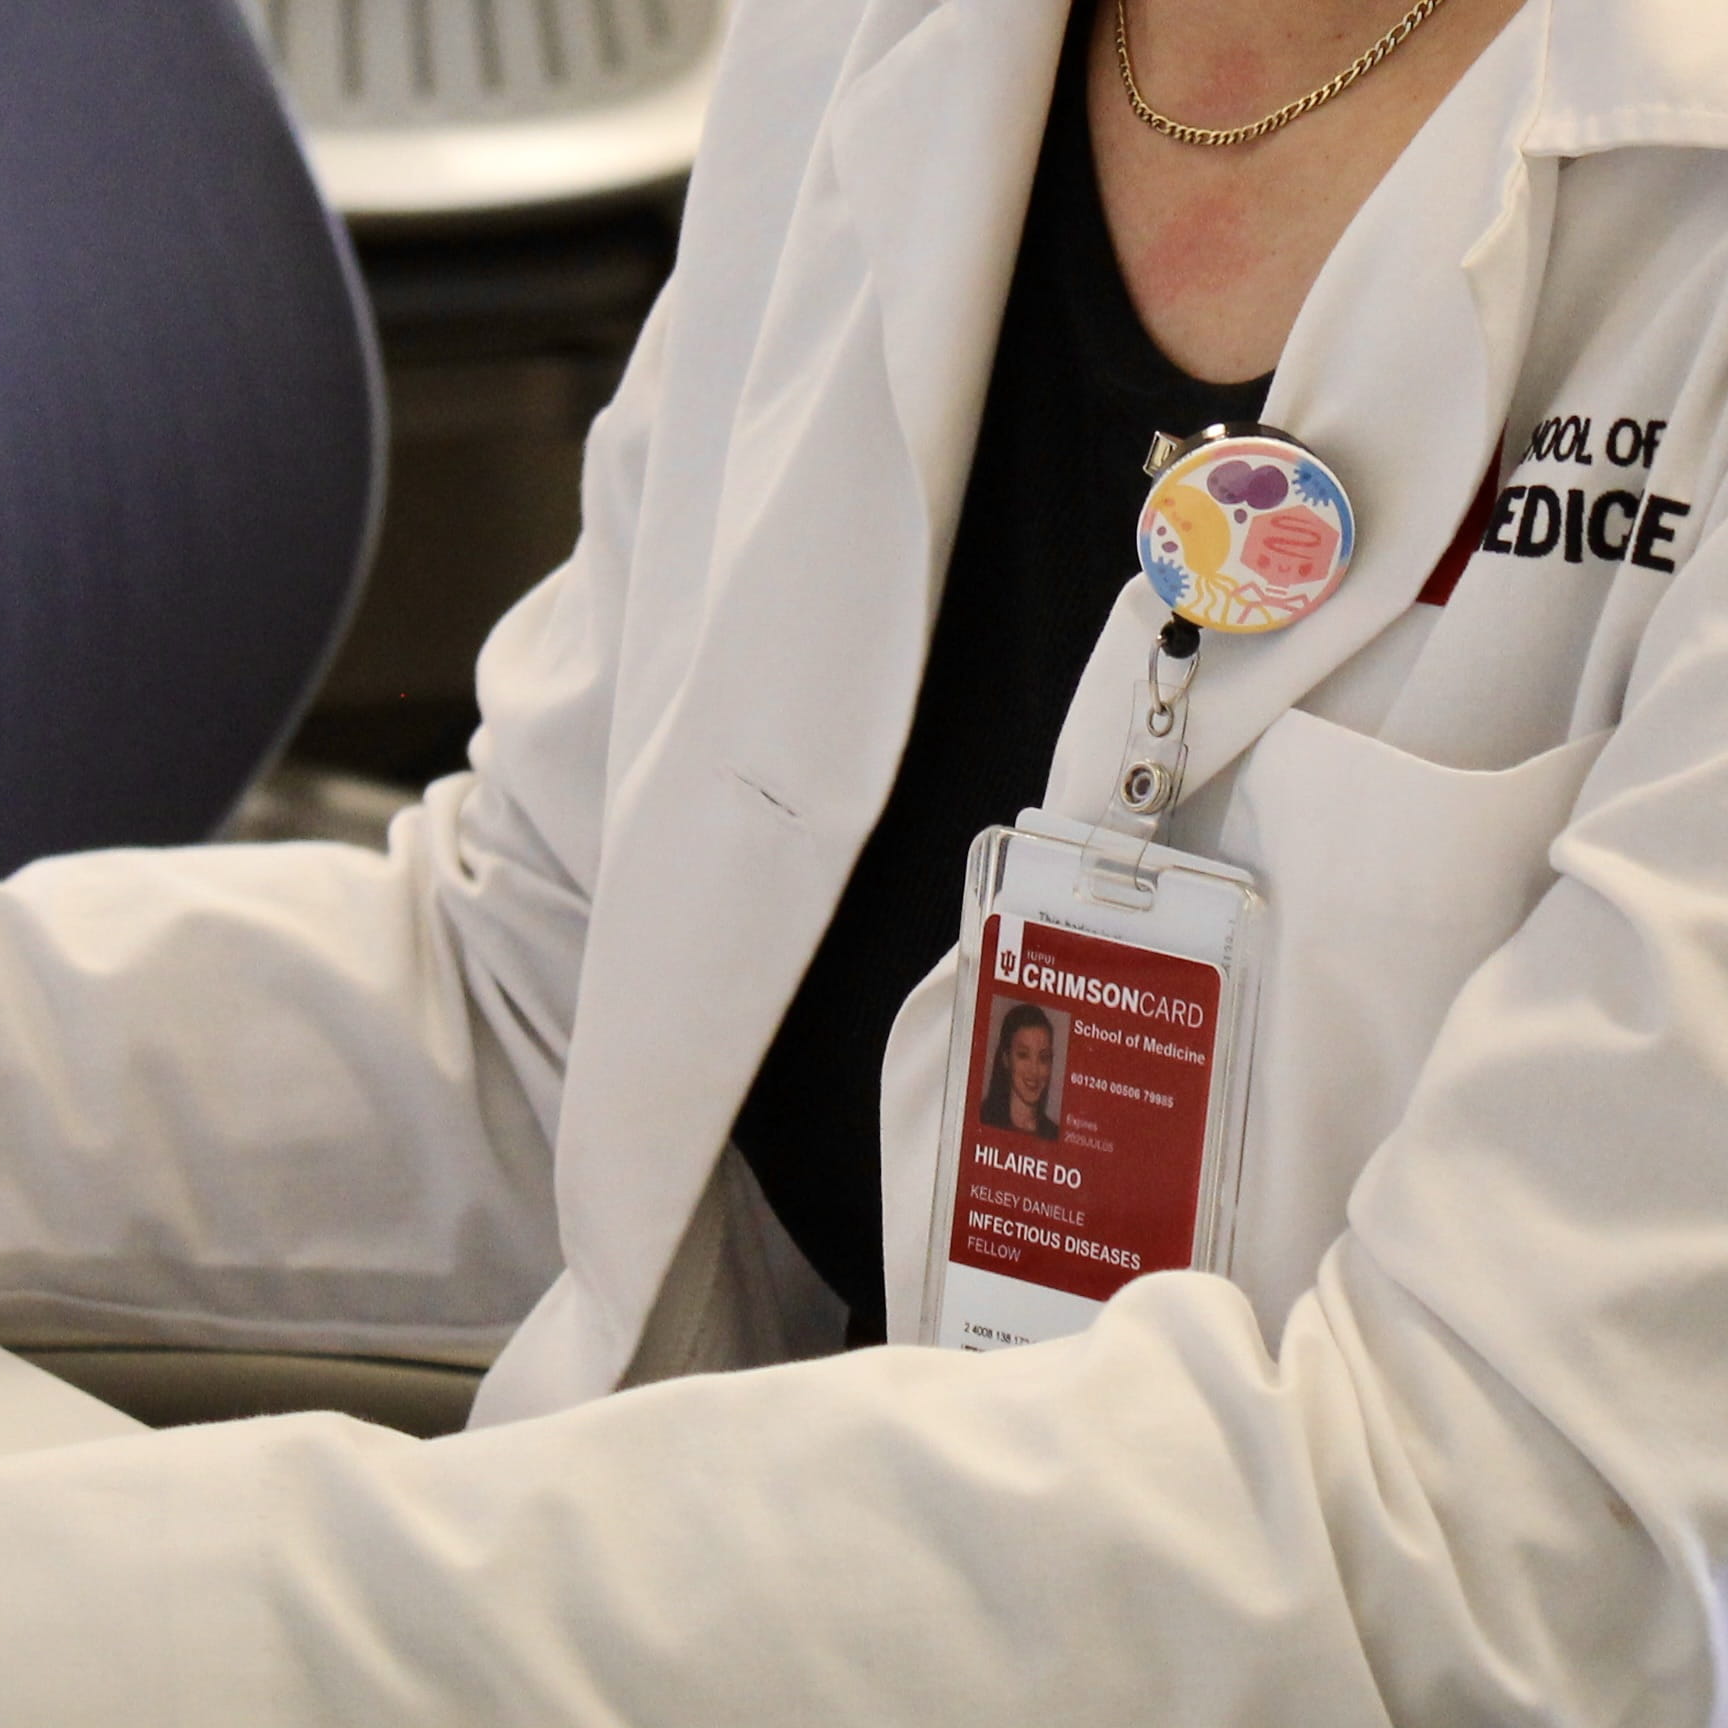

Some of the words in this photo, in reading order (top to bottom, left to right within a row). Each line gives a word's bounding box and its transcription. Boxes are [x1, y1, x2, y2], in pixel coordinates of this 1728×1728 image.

[1606, 418, 1667, 469] OF
[1027, 950, 1056, 965] IUPUI
[1022, 963, 1204, 1028] CRIMSONCARD
[1074, 1019, 1122, 1044] School
[1125, 1034, 1141, 1049] of
[1143, 1035, 1206, 1065] Medicine
[975, 1143, 1048, 1180] HILAIRE
[1053, 1164, 1082, 1189] DO
[970, 1184, 1020, 1209] KELSEY
[1023, 1197, 1085, 1227] DANIELLE
[967, 1235, 1021, 1262] FELLOW
[969, 1209, 1061, 1249] INFECTIOUS
[1065, 1235, 1141, 1271] DISEASES
